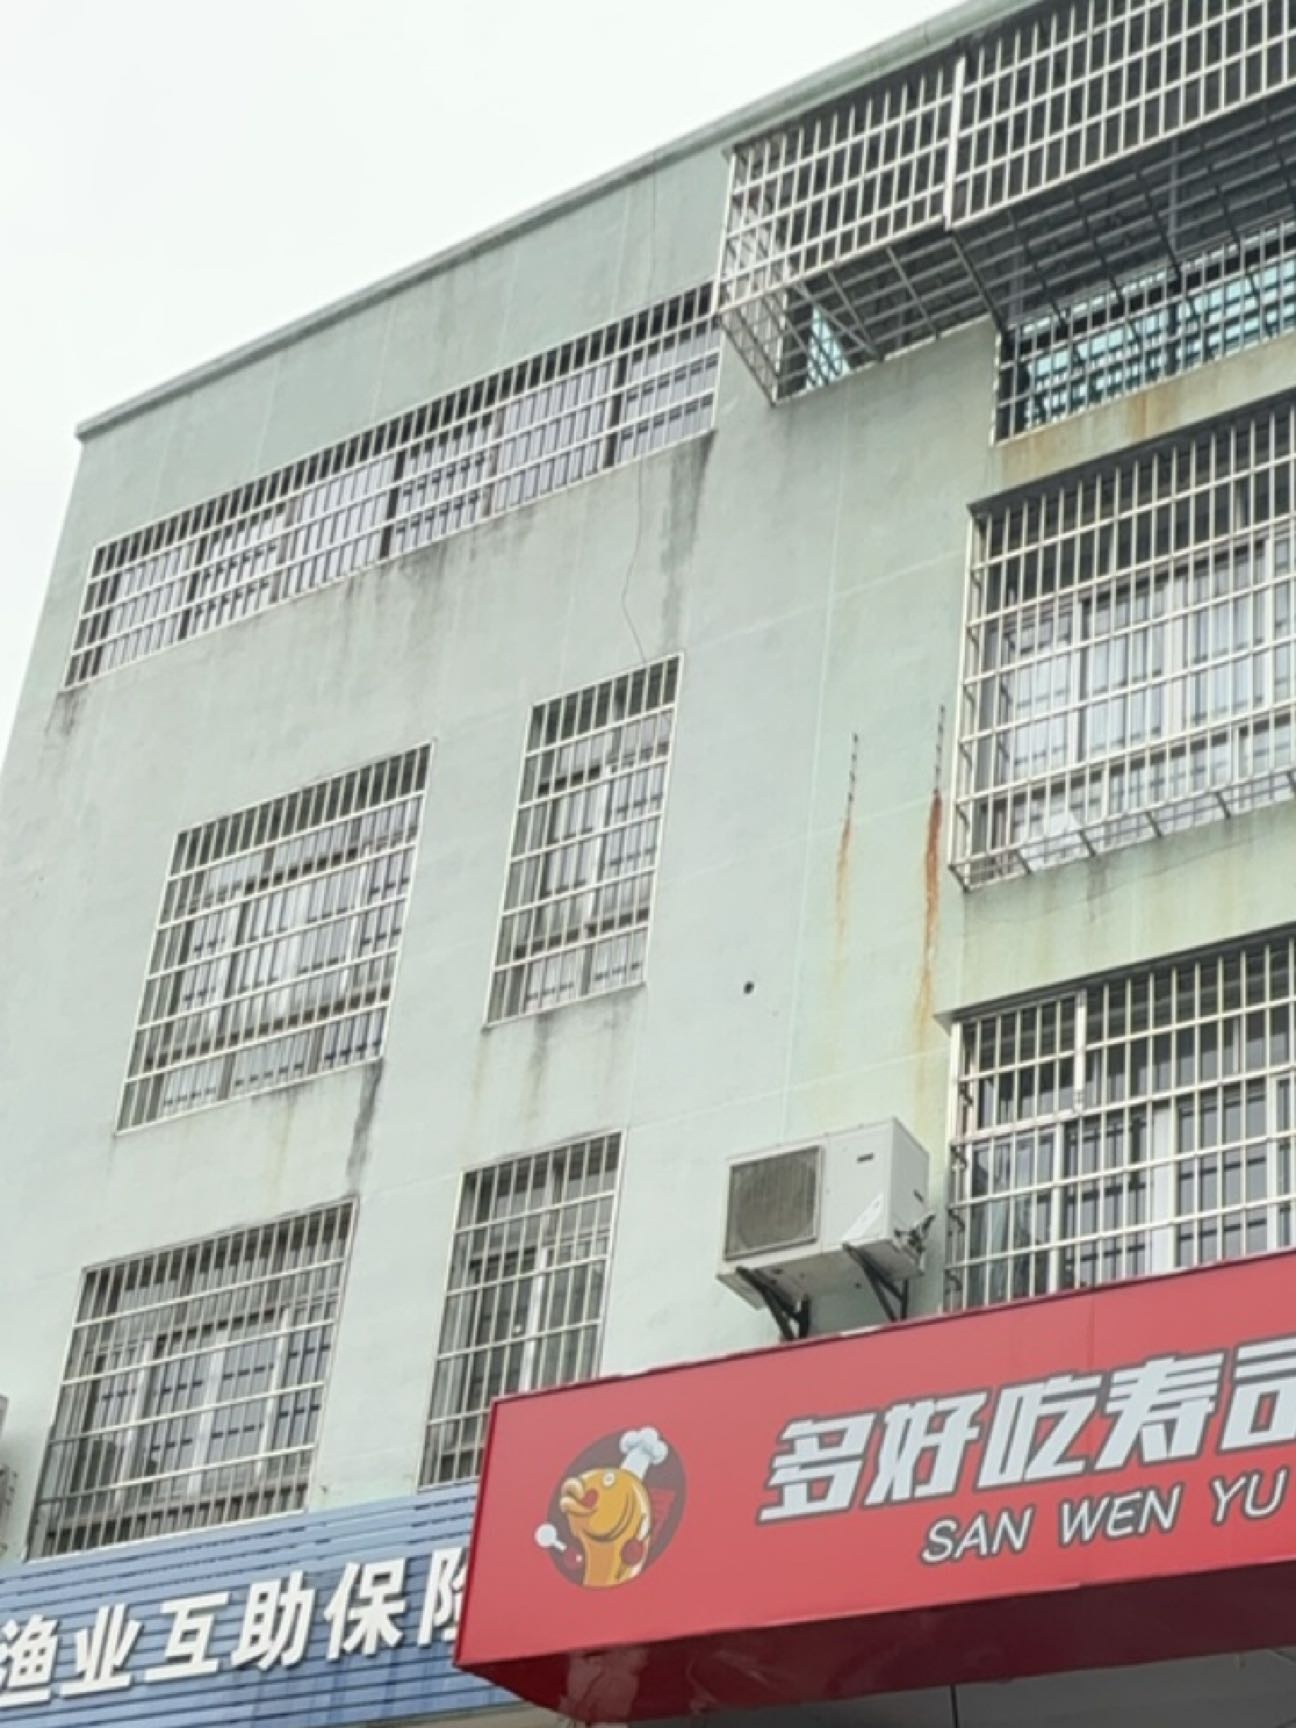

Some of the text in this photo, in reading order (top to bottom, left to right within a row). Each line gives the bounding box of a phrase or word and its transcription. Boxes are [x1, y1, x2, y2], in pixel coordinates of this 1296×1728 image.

[918, 1505, 1034, 1564] SAN
[1058, 1483, 1184, 1549] WEN
[1210, 1466, 1290, 1526] YU
